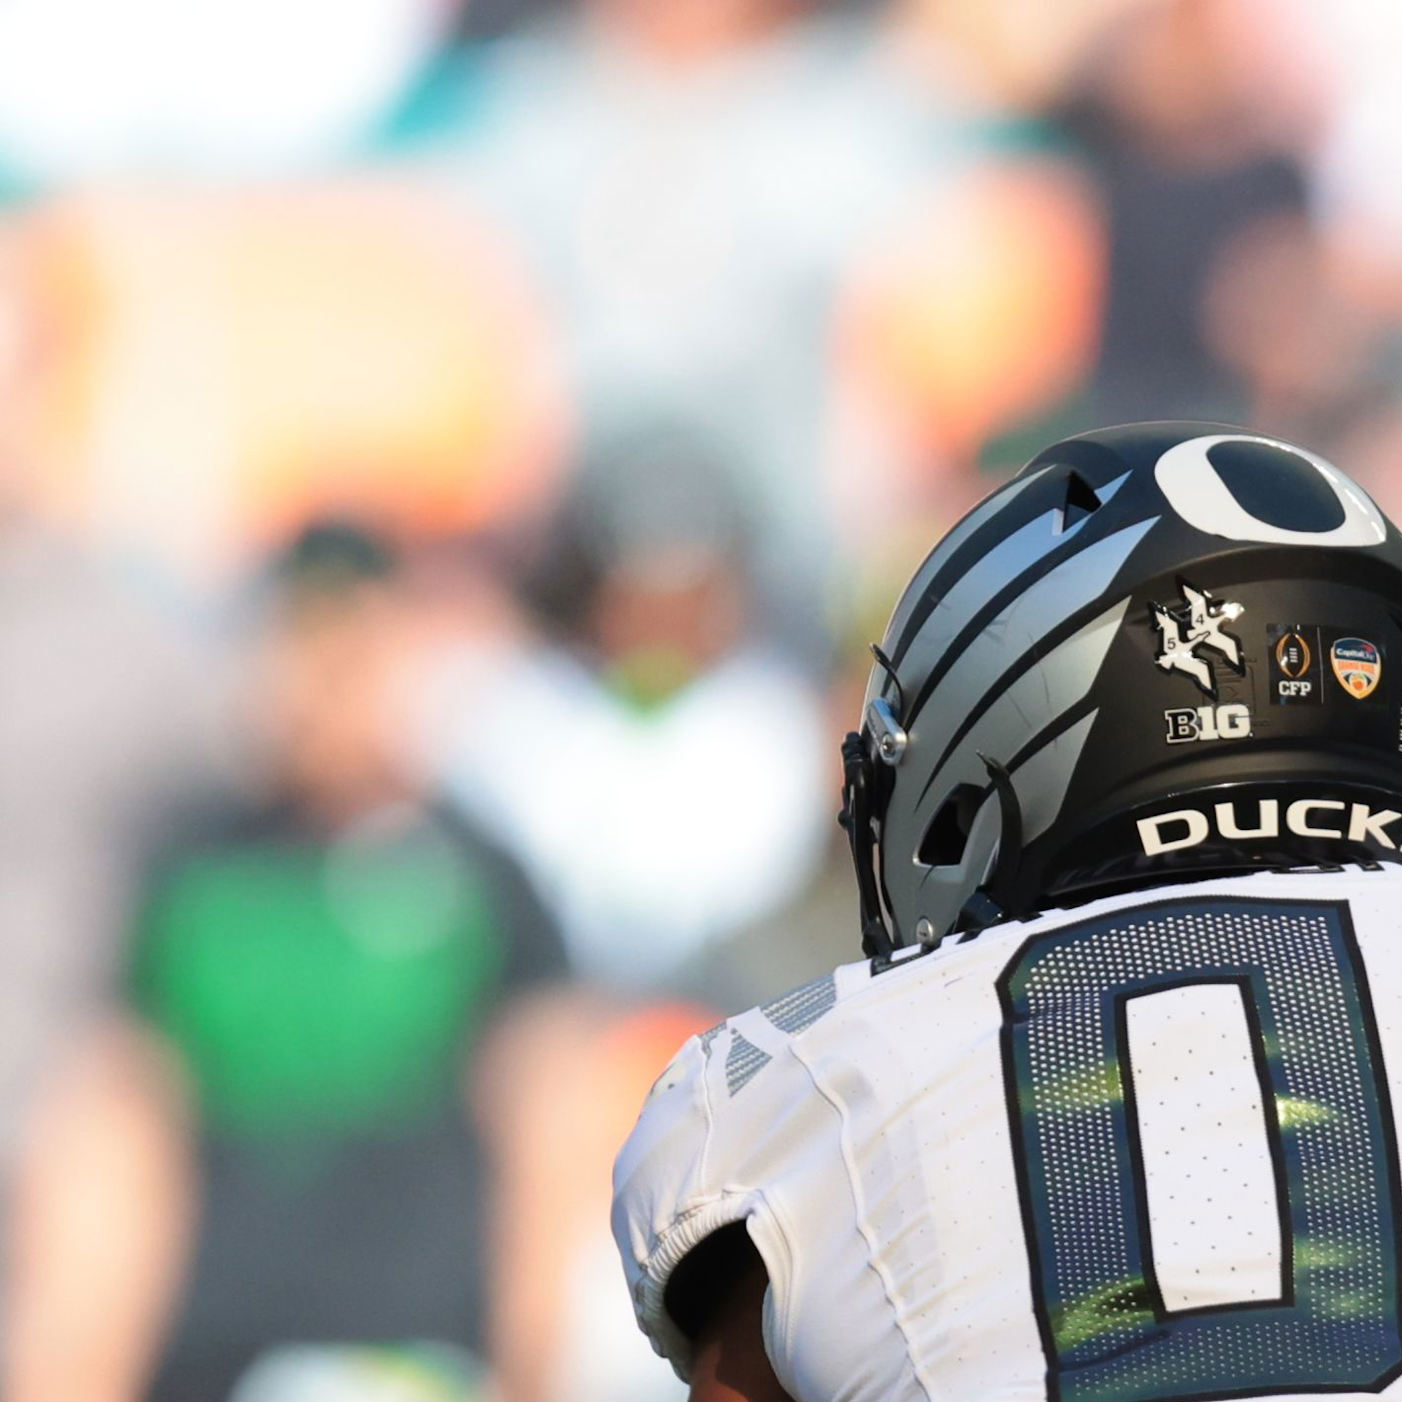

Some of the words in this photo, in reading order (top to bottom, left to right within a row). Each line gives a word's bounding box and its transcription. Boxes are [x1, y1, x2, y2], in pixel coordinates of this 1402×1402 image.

[1154, 434, 1388, 547] O
[1196, 614, 1205, 626] 4
[1167, 637, 1177, 650] 5
[1278, 680, 1312, 696] CFP
